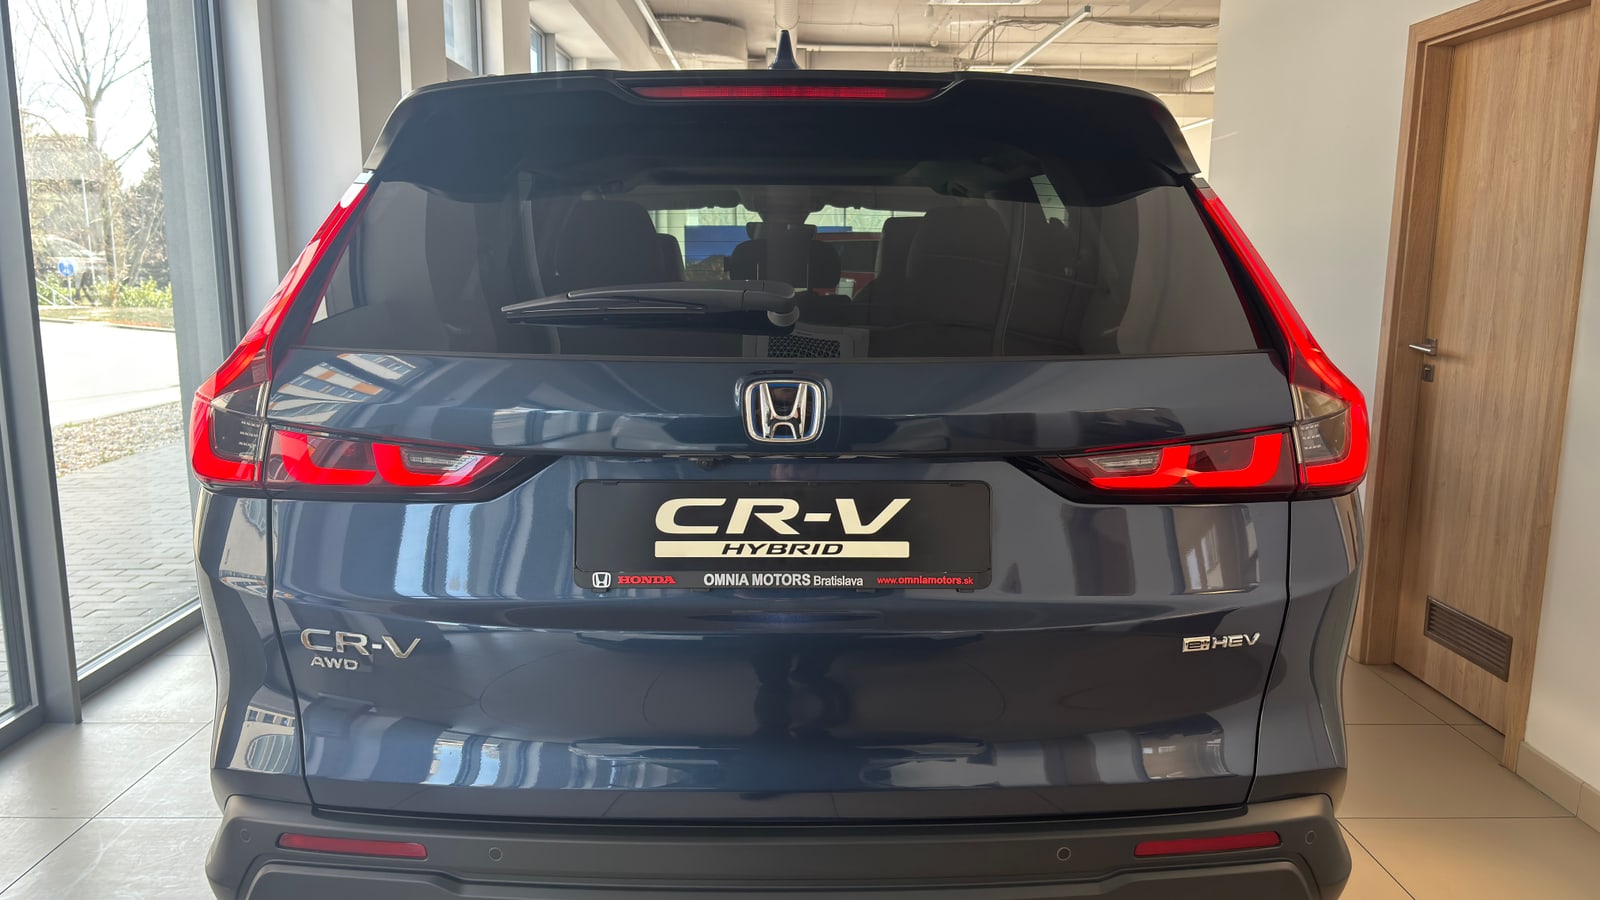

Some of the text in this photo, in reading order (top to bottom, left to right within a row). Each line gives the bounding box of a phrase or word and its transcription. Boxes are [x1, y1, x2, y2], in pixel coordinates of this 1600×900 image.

[655, 498, 911, 535] CR-V
[721, 543, 844, 555] HYBRID
[617, 575, 676, 585] HONDA
[703, 573, 864, 586] OMNIA MOTORS Bratislava
[876, 576, 974, 585] www.omniamotors.sk
[300, 628, 421, 659] CR-V
[310, 656, 359, 671] AWD
